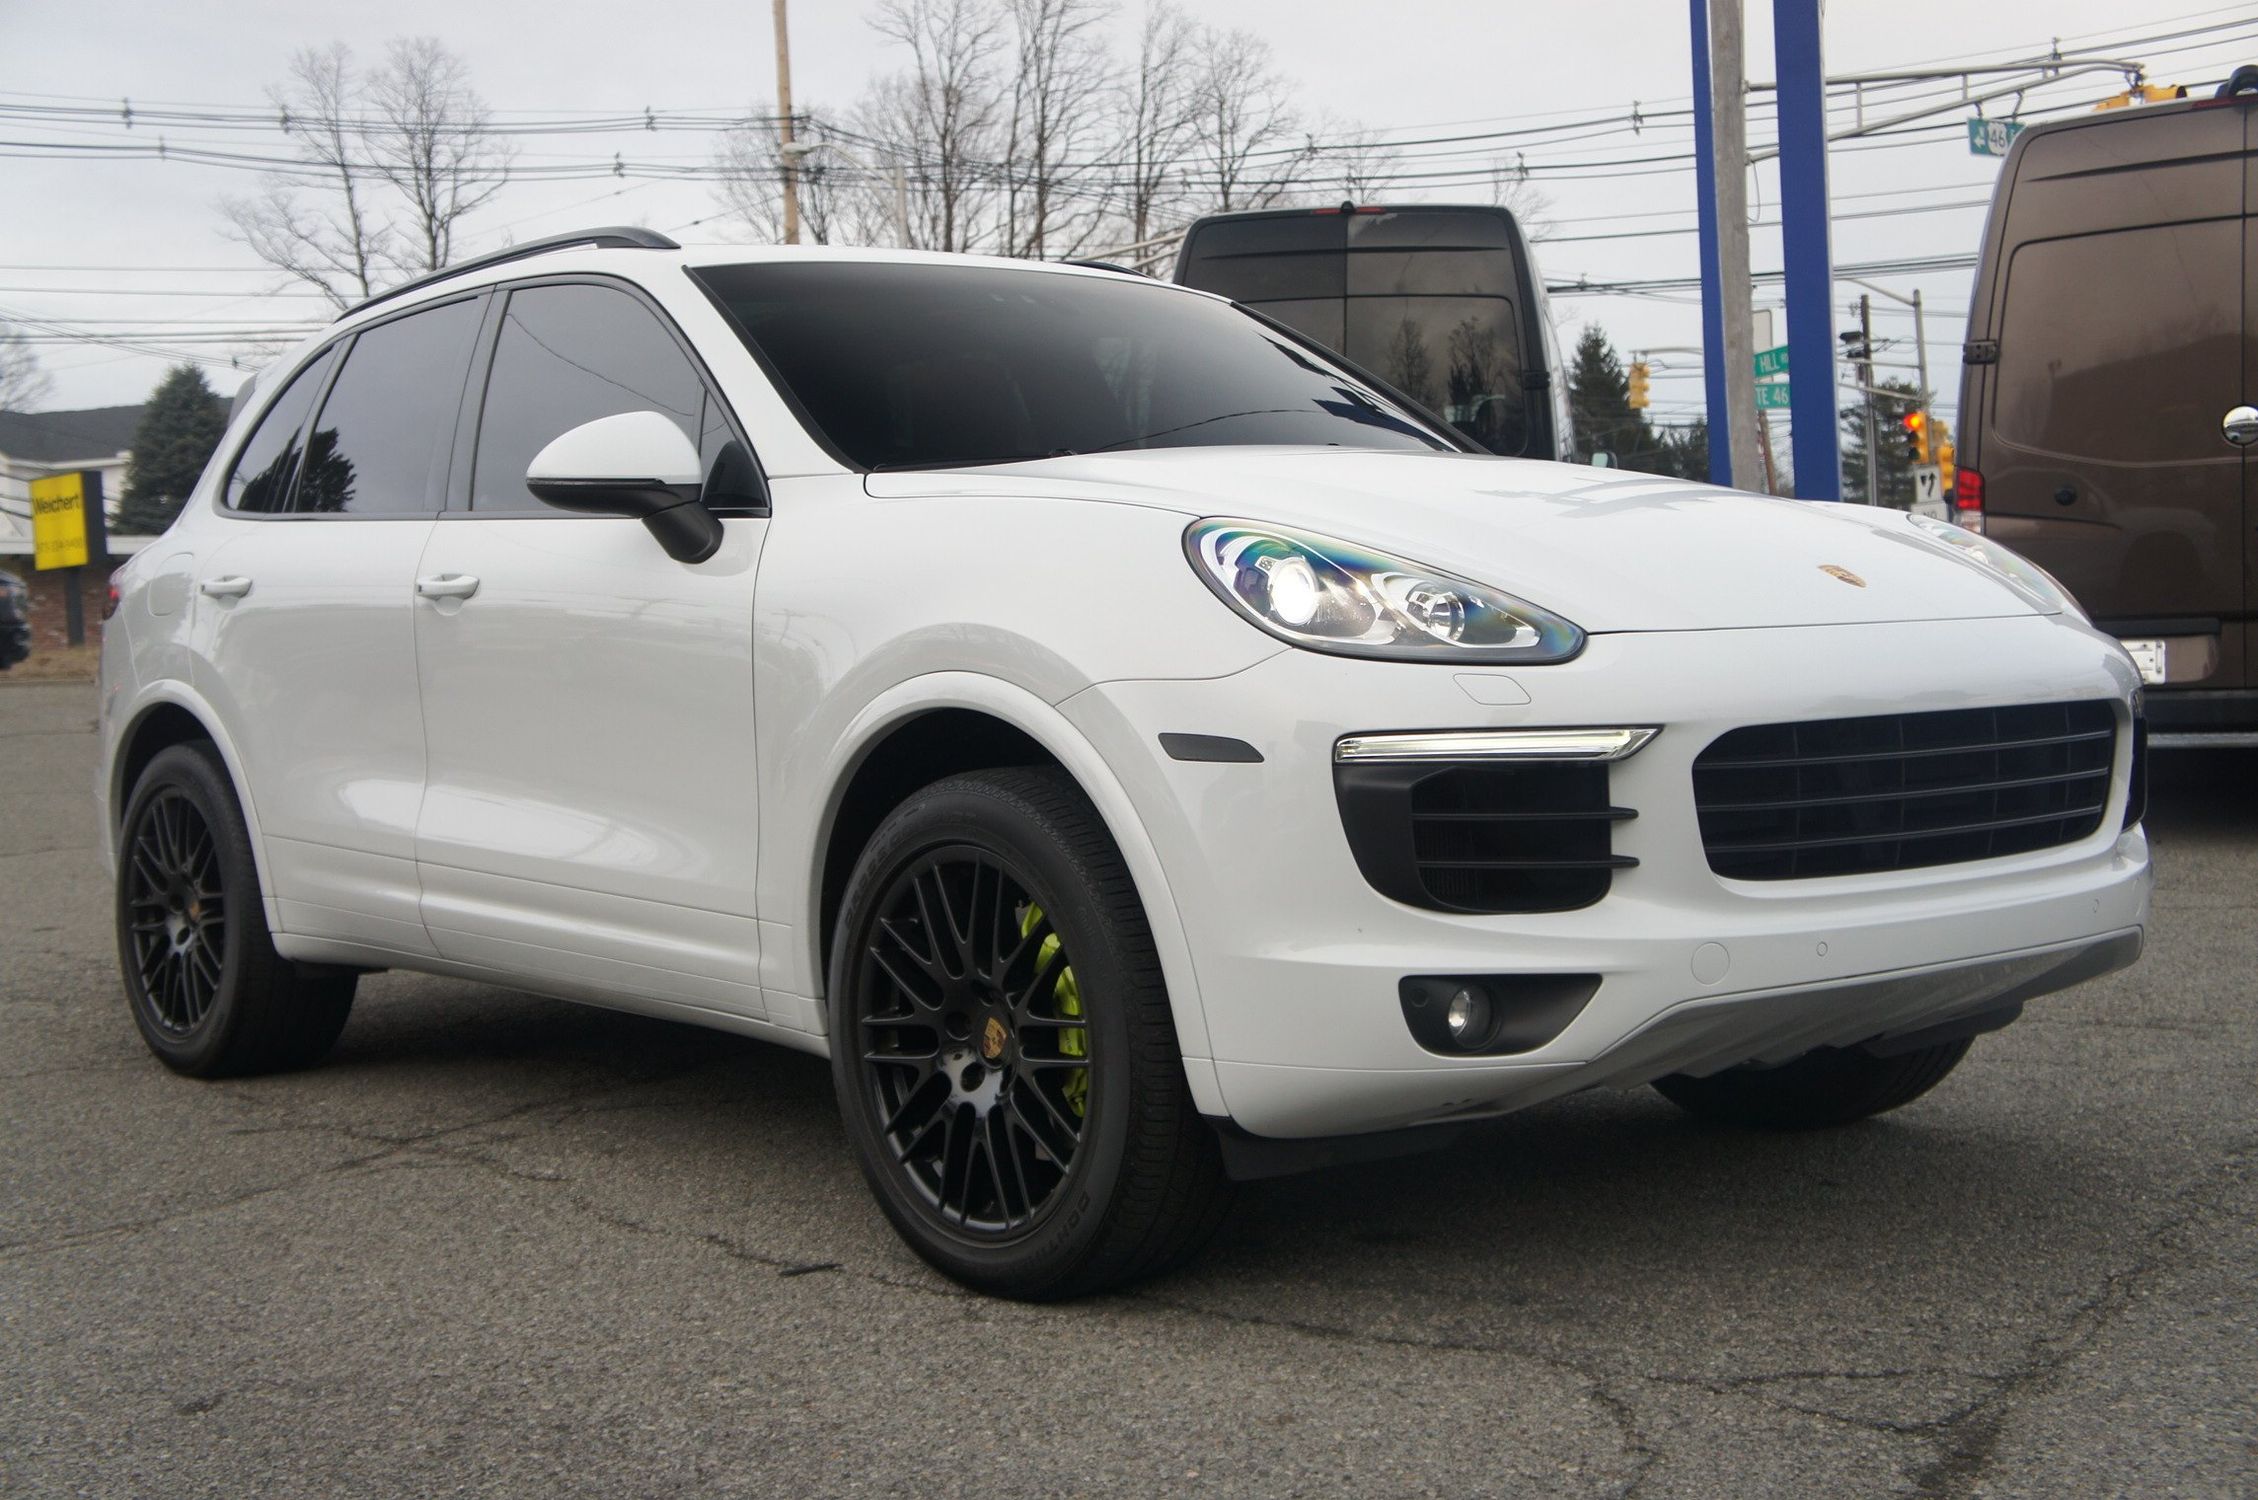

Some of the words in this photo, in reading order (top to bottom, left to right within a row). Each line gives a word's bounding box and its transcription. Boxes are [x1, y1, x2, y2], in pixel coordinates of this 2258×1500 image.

[1991, 129, 2005, 147] 46
[1755, 387, 1769, 405] TE
[1773, 387, 1789, 404] 46
